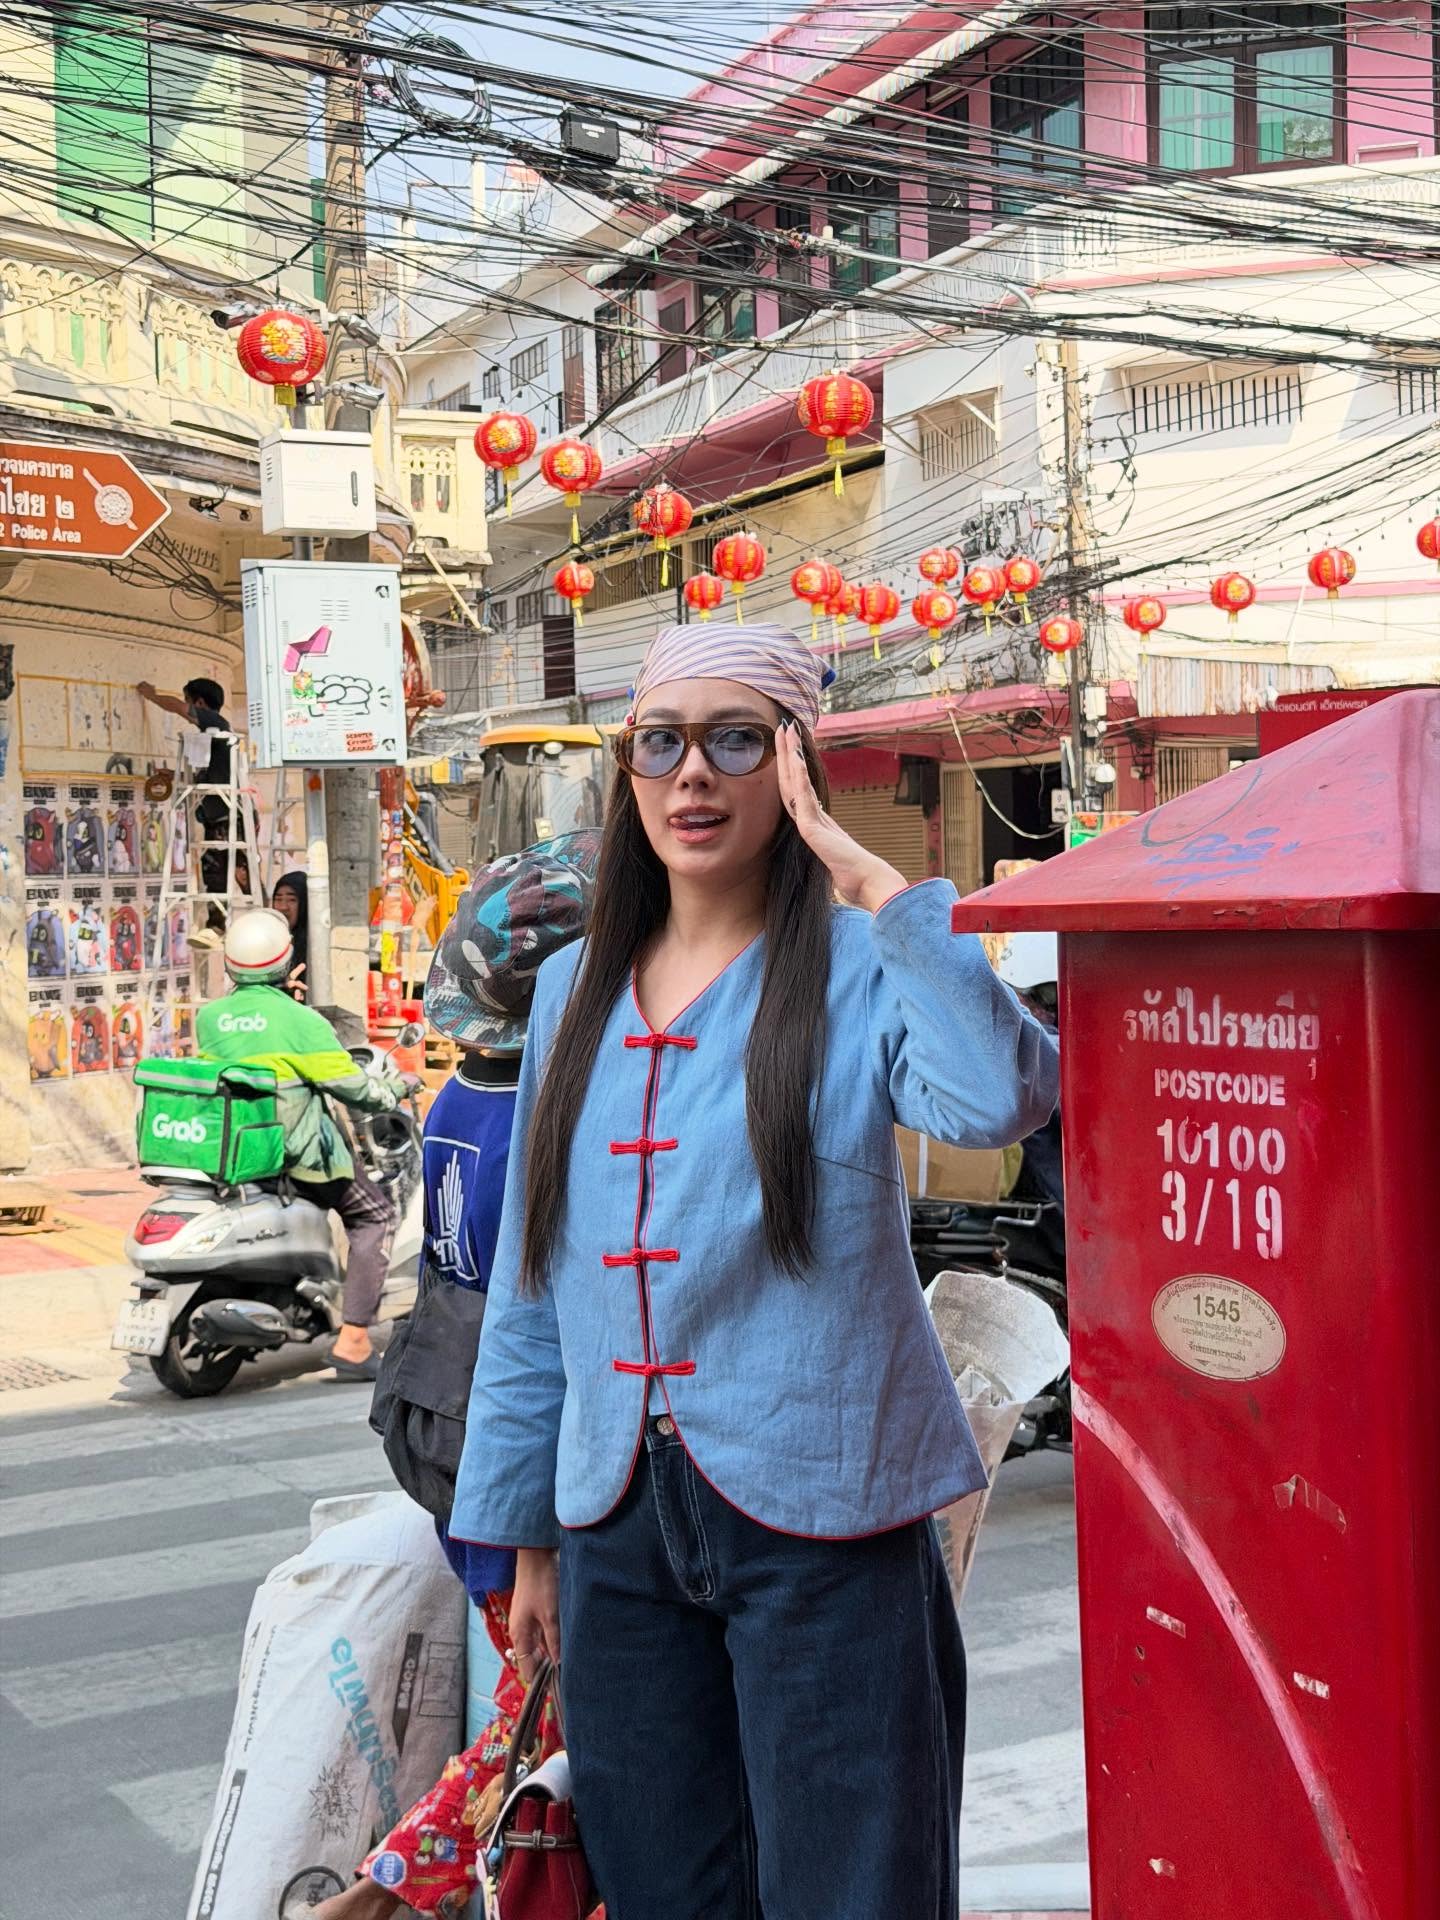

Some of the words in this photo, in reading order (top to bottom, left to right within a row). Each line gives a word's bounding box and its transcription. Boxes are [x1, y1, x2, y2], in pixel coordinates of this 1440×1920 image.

[55, 494, 75, 519] ๒
[11, 523, 48, 541] Police
[52, 527, 81, 543] Area
[217, 1013, 268, 1033] Grab
[1155, 1068, 1287, 1107] POSTCODE
[152, 1113, 207, 1144] Grab
[1156, 1115, 1287, 1176] 10100
[1161, 1169, 1283, 1260] 3/19
[1193, 1294, 1241, 1323] 1545
